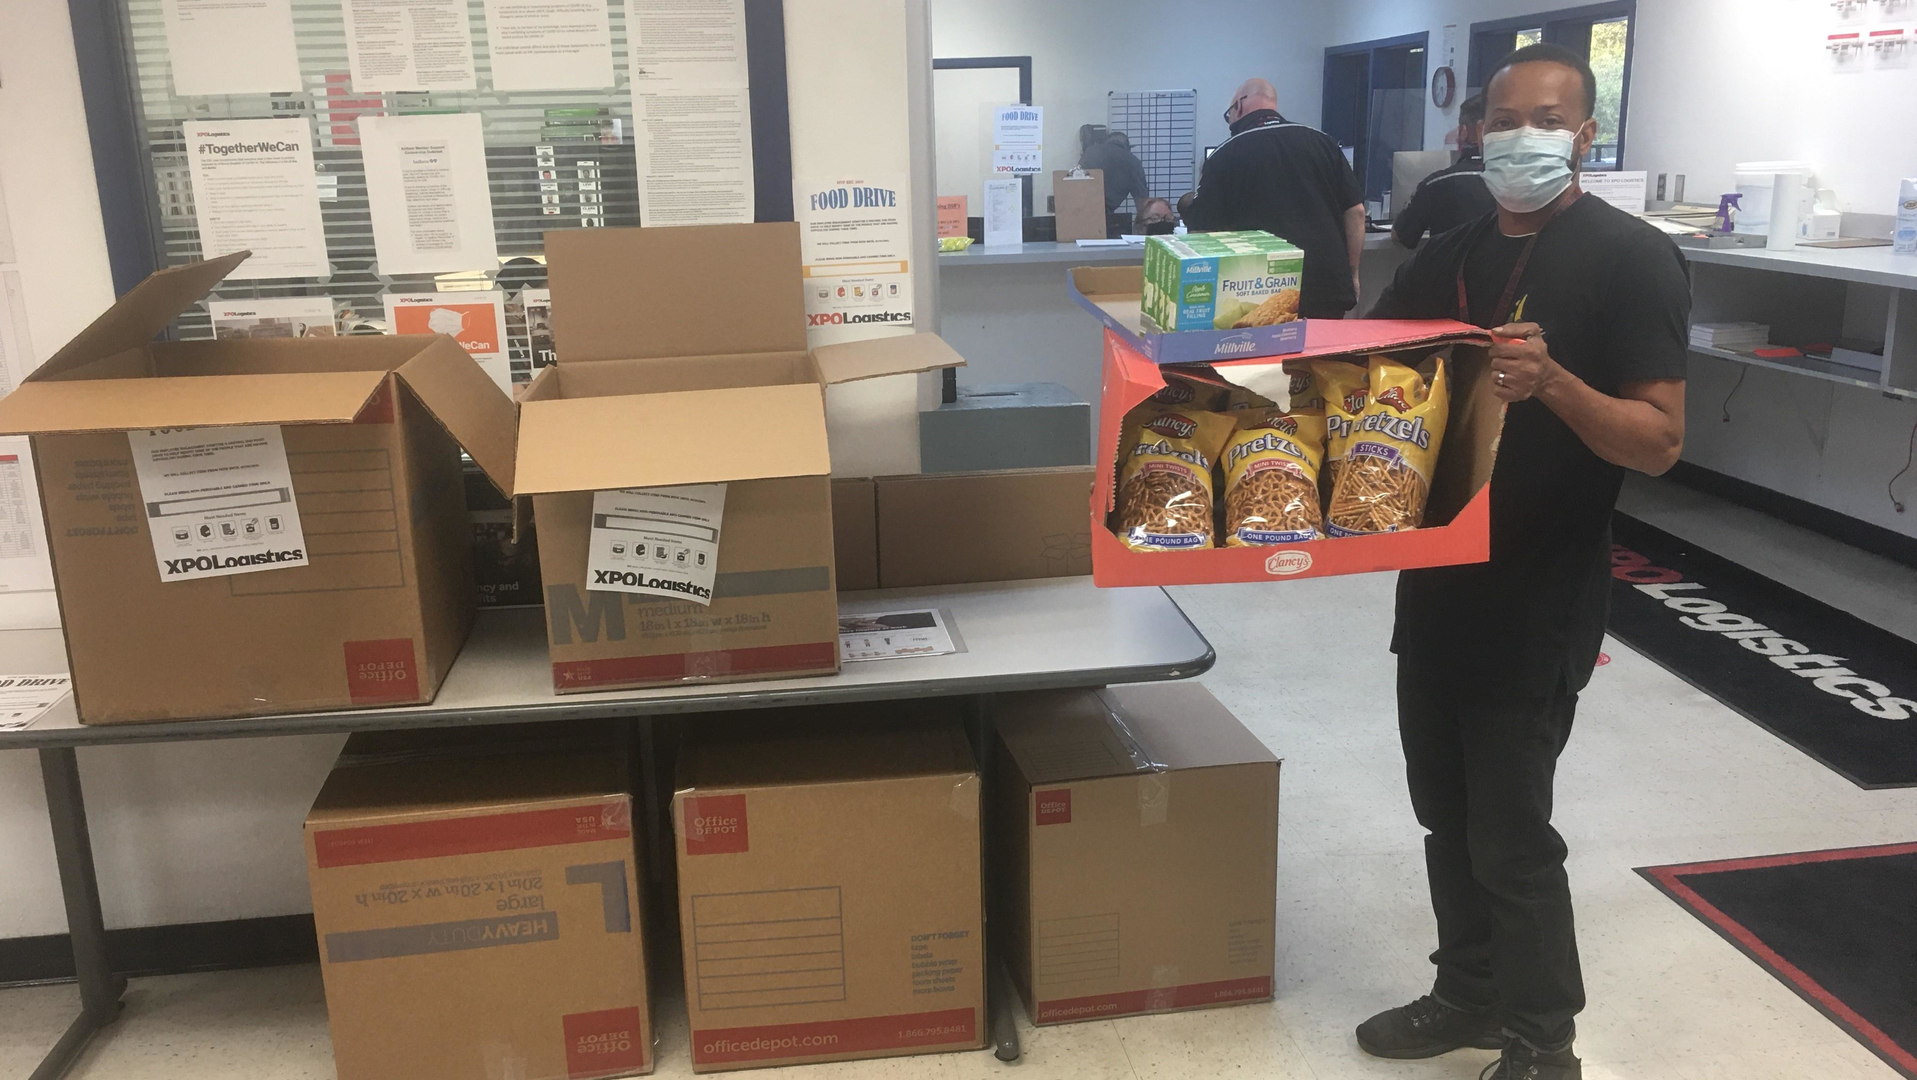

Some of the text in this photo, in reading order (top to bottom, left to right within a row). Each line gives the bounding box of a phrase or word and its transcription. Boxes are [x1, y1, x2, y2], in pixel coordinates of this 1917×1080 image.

[1002, 111, 1038, 121] FOOD DRIVE
[198, 141, 300, 156] #TogetherWeCan
[810, 187, 896, 211] FOOD DRIVE
[1186, 264, 1212, 274] Millville
[1222, 276, 1298, 292] FRUIT & GRAIN
[807, 311, 911, 326] XPOLogistics
[1214, 341, 1256, 355] Millville
[1359, 444, 1389, 456] STICKS
[1165, 463, 1188, 474] TWISTS
[1246, 533, 1264, 541] ONE
[1264, 533, 1292, 542] POUND
[1329, 528, 1344, 536] ONE
[1154, 537, 1181, 545] POUND
[1183, 537, 1199, 545] BAG
[164, 549, 303, 575] XPOLogistics
[1267, 553, 1310, 571] Clancy's
[499, 581, 519, 591] and
[594, 570, 711, 600] XPOLogistics
[547, 583, 626, 645] M
[637, 602, 704, 618] medium
[711, 617, 723, 627] w
[725, 616, 733, 624] x
[735, 613, 760, 624] 18in
[761, 611, 772, 623] h
[358, 661, 405, 671] DEPOT
[359, 670, 407, 682] Office
[1040, 801, 1066, 809] Office
[575, 815, 595, 824] USA
[694, 816, 738, 828] Office
[696, 825, 738, 835] DEPOT
[445, 882, 481, 897] 20in
[484, 882, 494, 892] x
[508, 877, 542, 890] 20in
[372, 890, 409, 905] 20in
[411, 888, 422, 899] x
[425, 886, 442, 897] w
[565, 860, 631, 933] L
[355, 894, 369, 907] h
[496, 894, 546, 911] large
[1041, 1002, 1117, 1019] officedepot.com
[577, 1030, 631, 1045] DEPOT
[703, 1024, 967, 1055] officedepot.com 1.866.795.8481
[577, 1040, 631, 1054] Office
